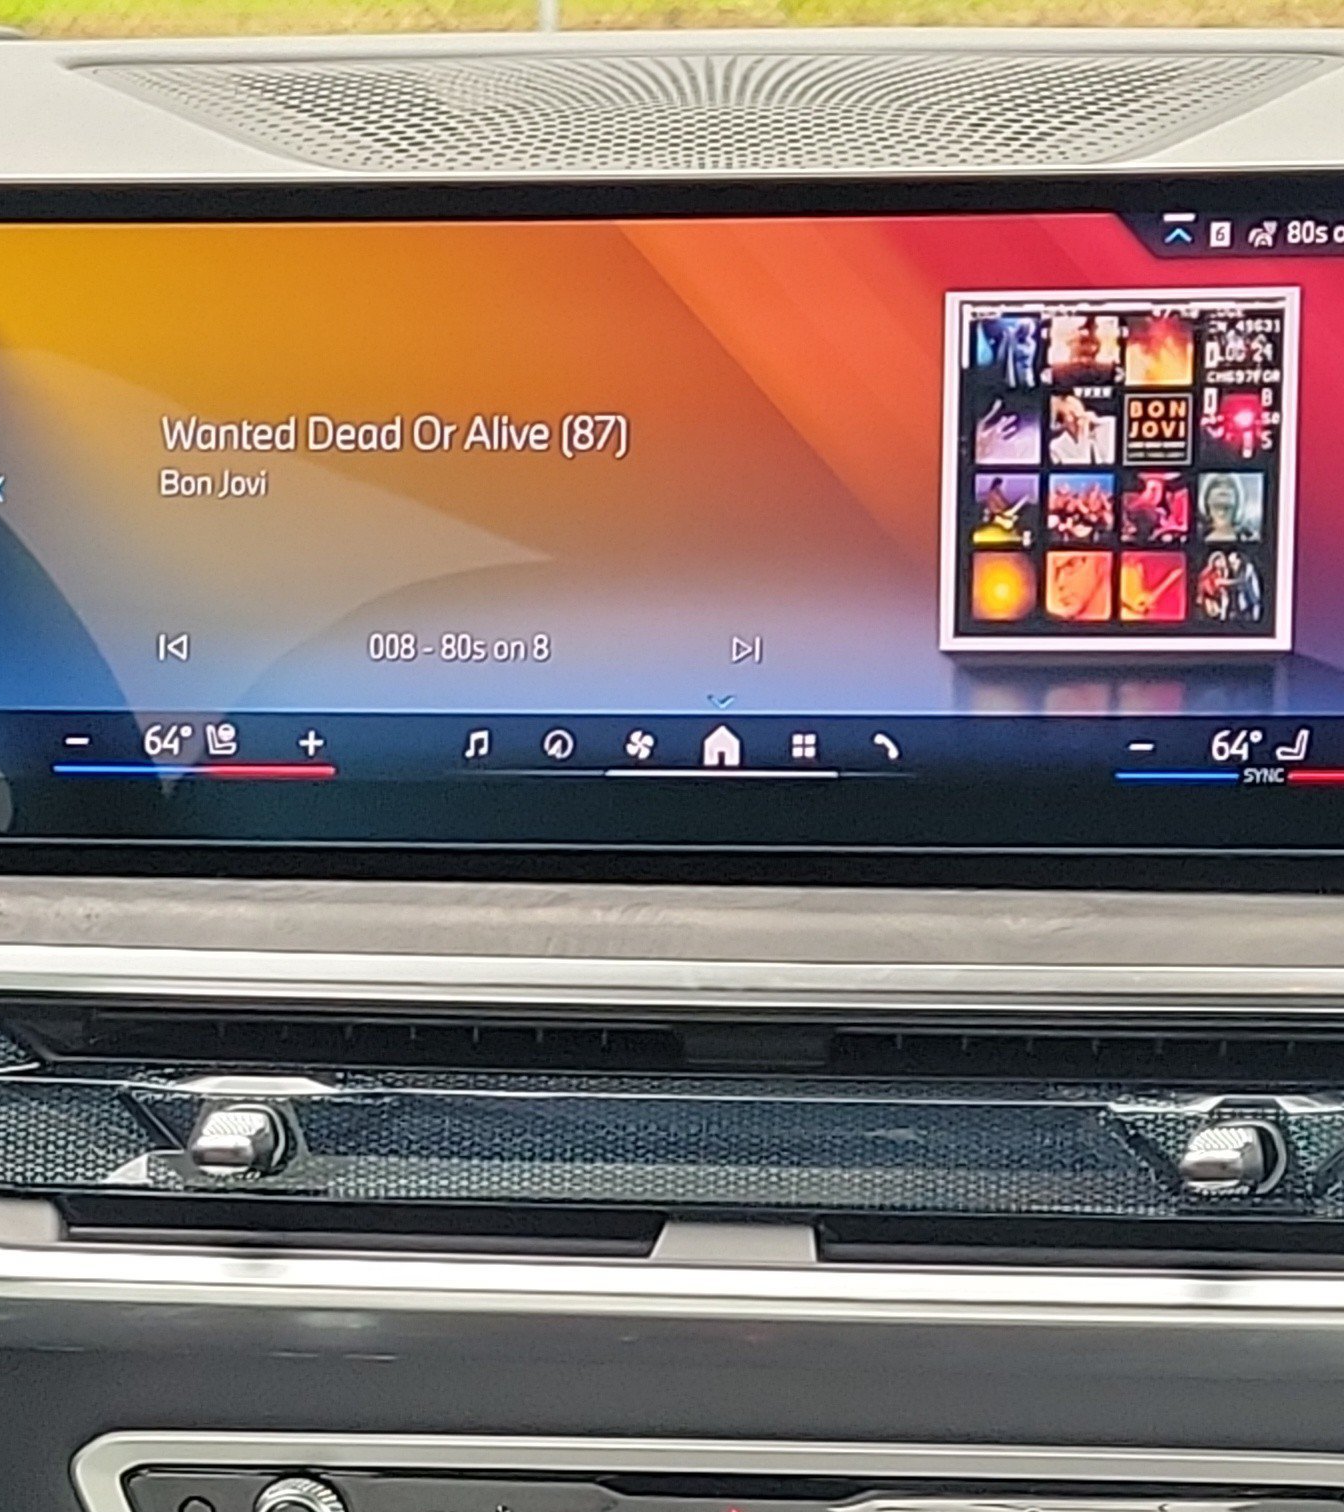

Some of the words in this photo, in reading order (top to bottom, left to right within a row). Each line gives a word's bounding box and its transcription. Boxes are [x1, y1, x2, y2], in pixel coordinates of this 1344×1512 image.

[1286, 220, 1328, 244] 80s
[1129, 400, 1187, 418] BON
[160, 414, 296, 451] Wanted
[308, 415, 402, 451] Dead
[412, 416, 458, 451] Or
[463, 415, 551, 451] Alive
[561, 413, 631, 459] (87)
[1128, 420, 1187, 439] JOVI
[160, 469, 213, 497] Bon
[217, 469, 269, 498] Jovi
[369, 633, 416, 661] 008
[440, 633, 488, 661] 80s
[493, 639, 526, 661] on
[532, 633, 551, 661] 8
[1243, 768, 1286, 785] SYNC
